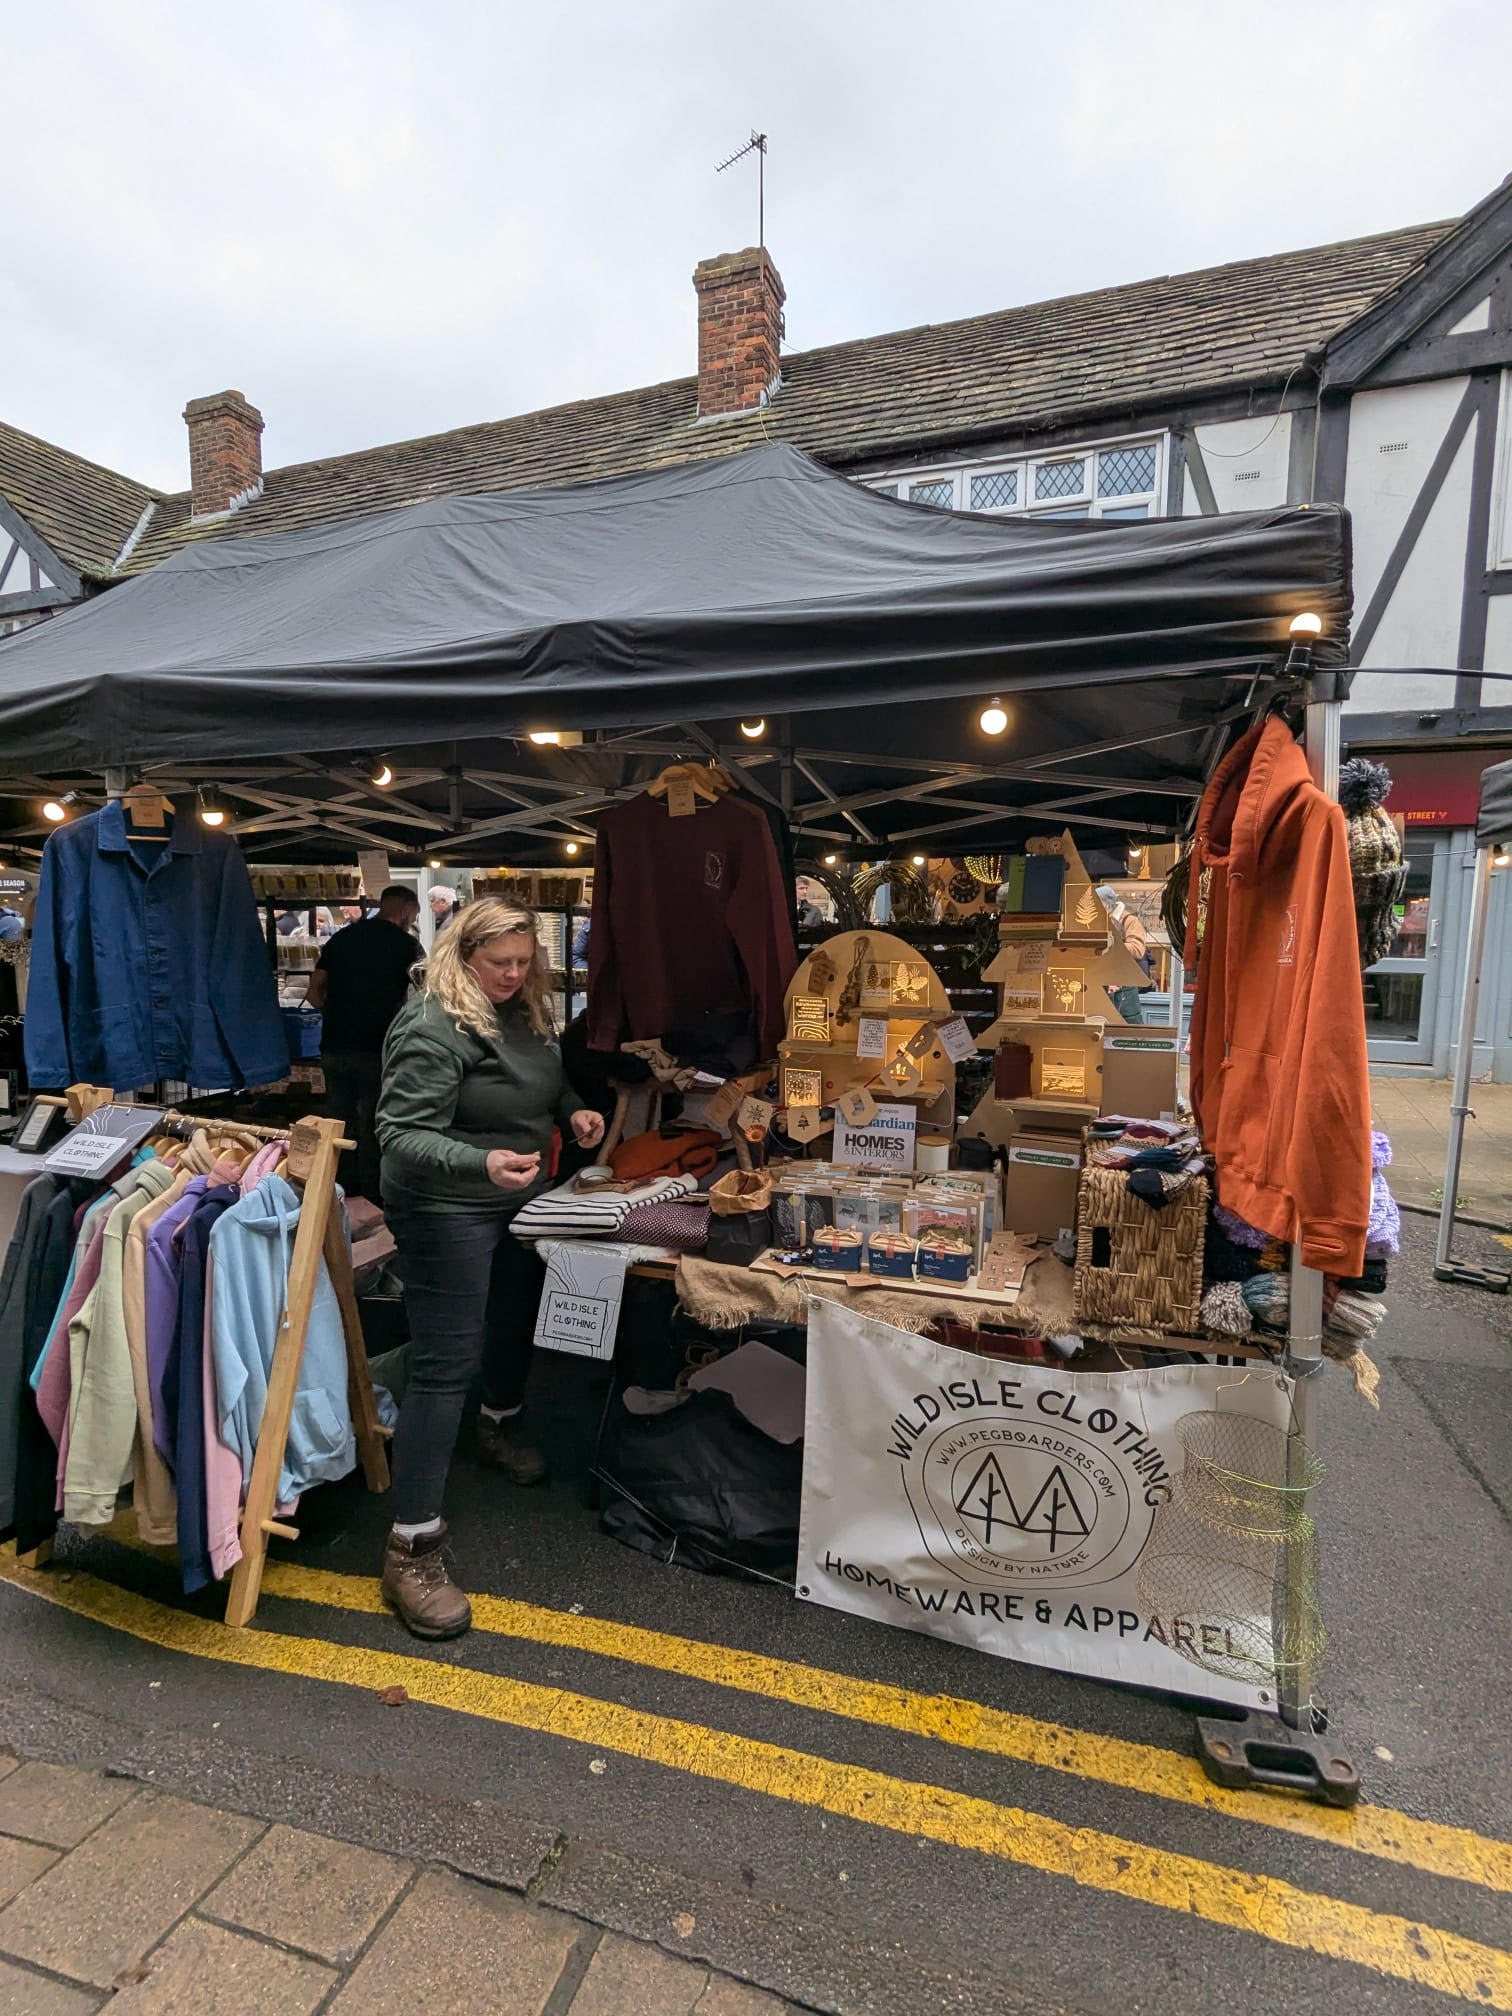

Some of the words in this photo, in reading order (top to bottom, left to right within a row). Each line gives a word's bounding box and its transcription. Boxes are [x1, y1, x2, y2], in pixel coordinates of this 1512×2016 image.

[1407, 811, 1436, 820] STREET
[845, 1133, 905, 1151] HOMES
[63, 1148, 106, 1159] CLOTHING
[554, 1299, 577, 1311] WILD
[579, 1305, 599, 1315] ISLE
[553, 1314, 597, 1329] CLOTHING
[886, 1393, 941, 1461] WILD
[939, 1379, 1024, 1411] ISLE
[1036, 1390, 1172, 1508] CLOTHING
[936, 1430, 1116, 1498] WWW.PEGBOARDERS.COM
[954, 1528, 1000, 1568] DESIGN
[1004, 1563, 1025, 1574] BY
[1031, 1550, 1090, 1574] NATURE
[825, 1551, 1025, 1623] HOMEWARE
[1034, 1598, 1053, 1624] &
